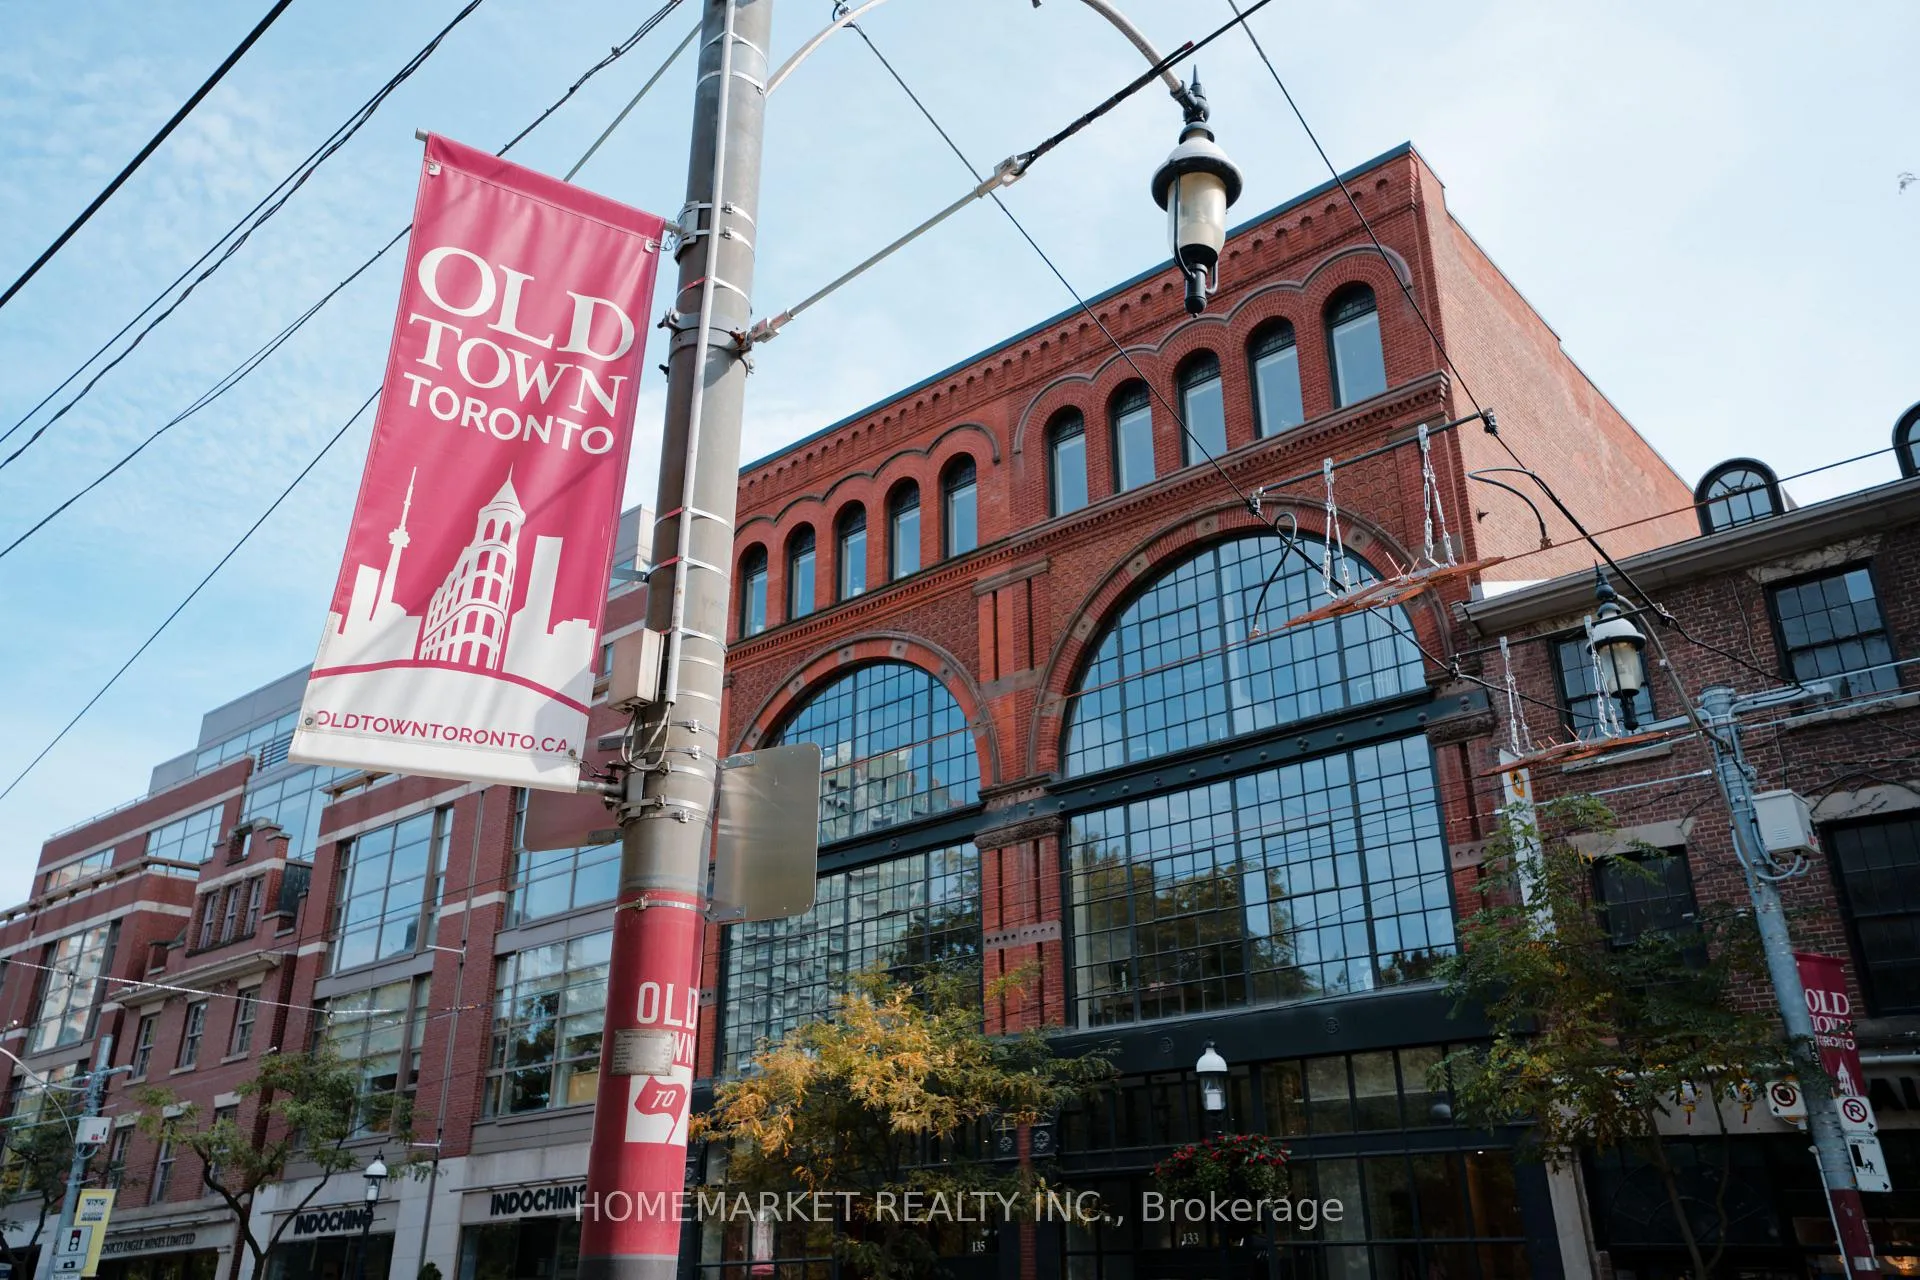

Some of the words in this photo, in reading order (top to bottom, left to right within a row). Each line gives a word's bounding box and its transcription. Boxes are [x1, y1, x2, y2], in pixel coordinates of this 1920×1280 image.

[418, 246, 635, 362] OLD
[409, 313, 628, 417] TOWN
[404, 372, 614, 455] TORONTO
[317, 710, 567, 753] OLDTOWNTORONTO.CA
[637, 982, 698, 1029] OLD
[1805, 989, 1850, 1015] OLD
[651, 1090, 677, 1109] TO
[295, 1208, 373, 1234] INDOCHIN
